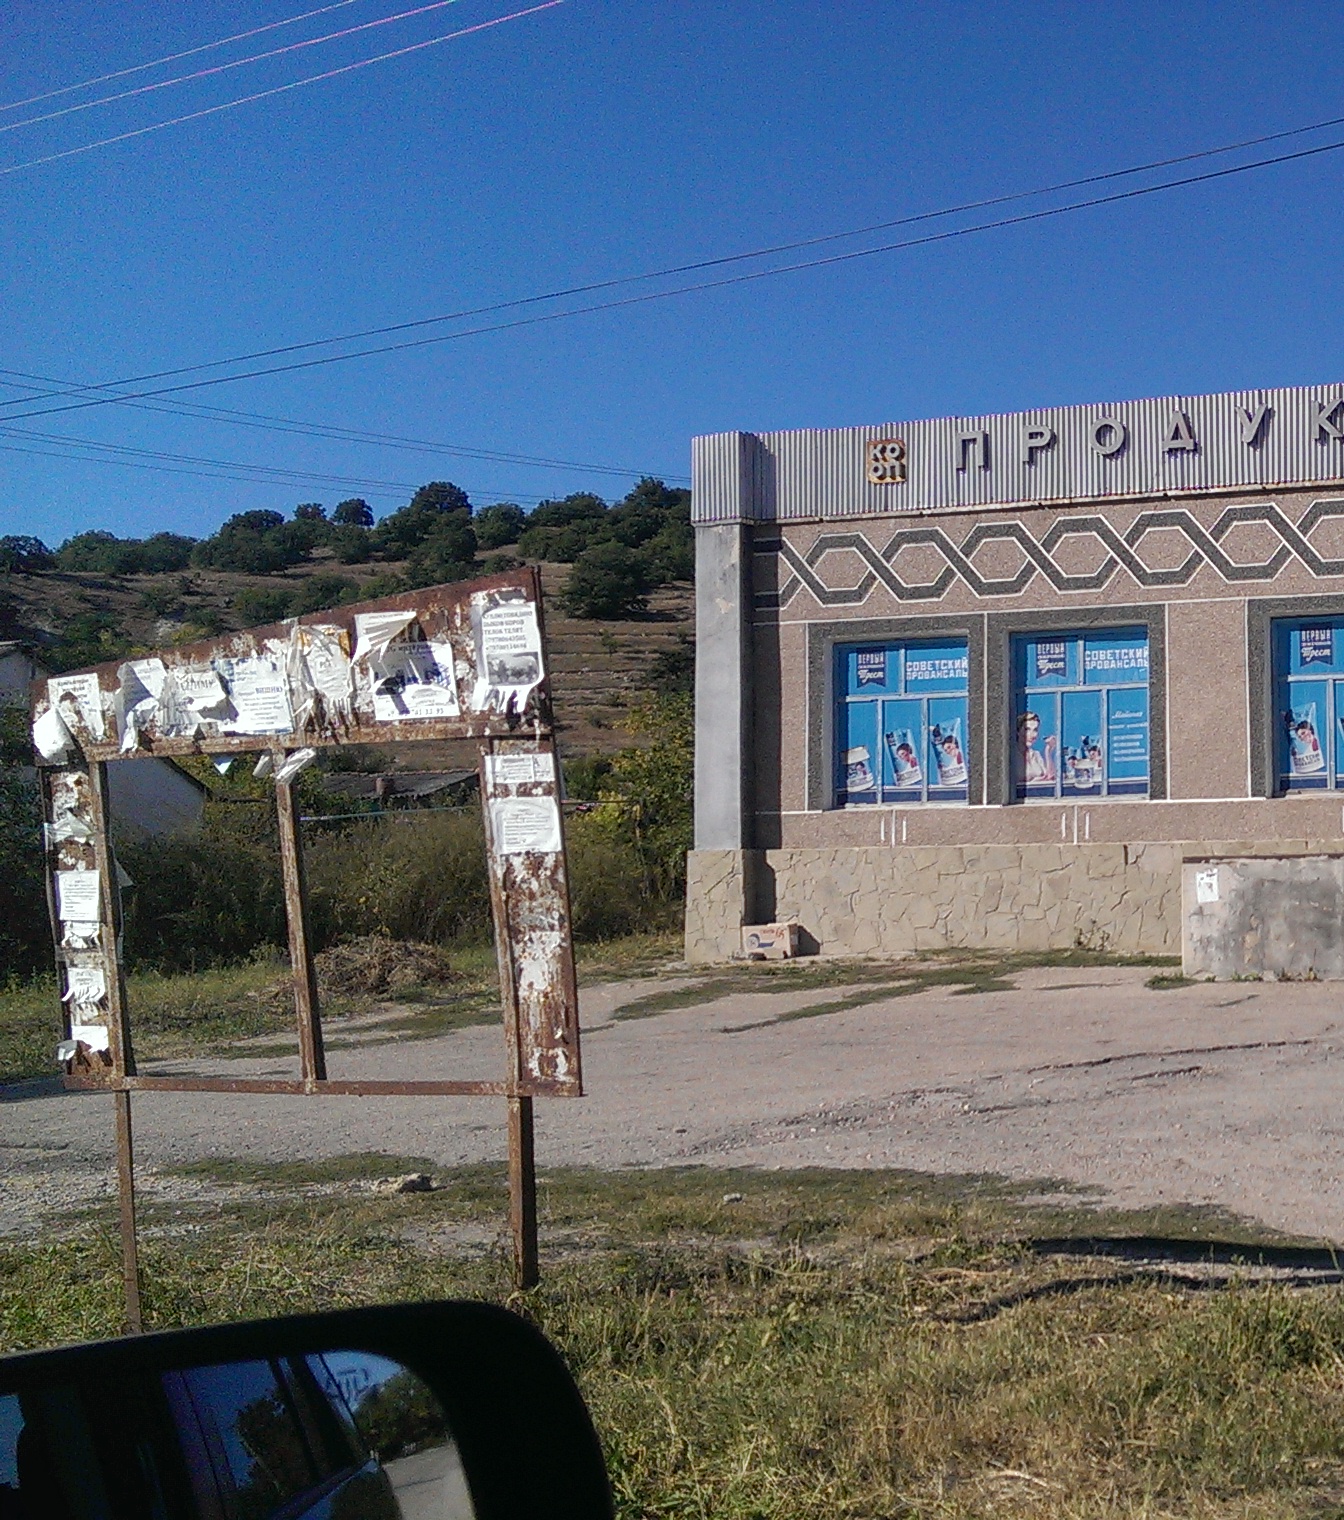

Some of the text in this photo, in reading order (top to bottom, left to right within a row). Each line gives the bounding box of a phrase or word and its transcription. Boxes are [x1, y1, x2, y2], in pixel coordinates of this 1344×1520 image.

[1085, 646, 1149, 660] СОВЕТСКИЙ
[906, 657, 968, 671] СОВЕТСКИЙ
[1085, 659, 1149, 670] ПРОВАНСАЛЬ
[906, 669, 968, 680] ПРОВАНСАЛЬ
